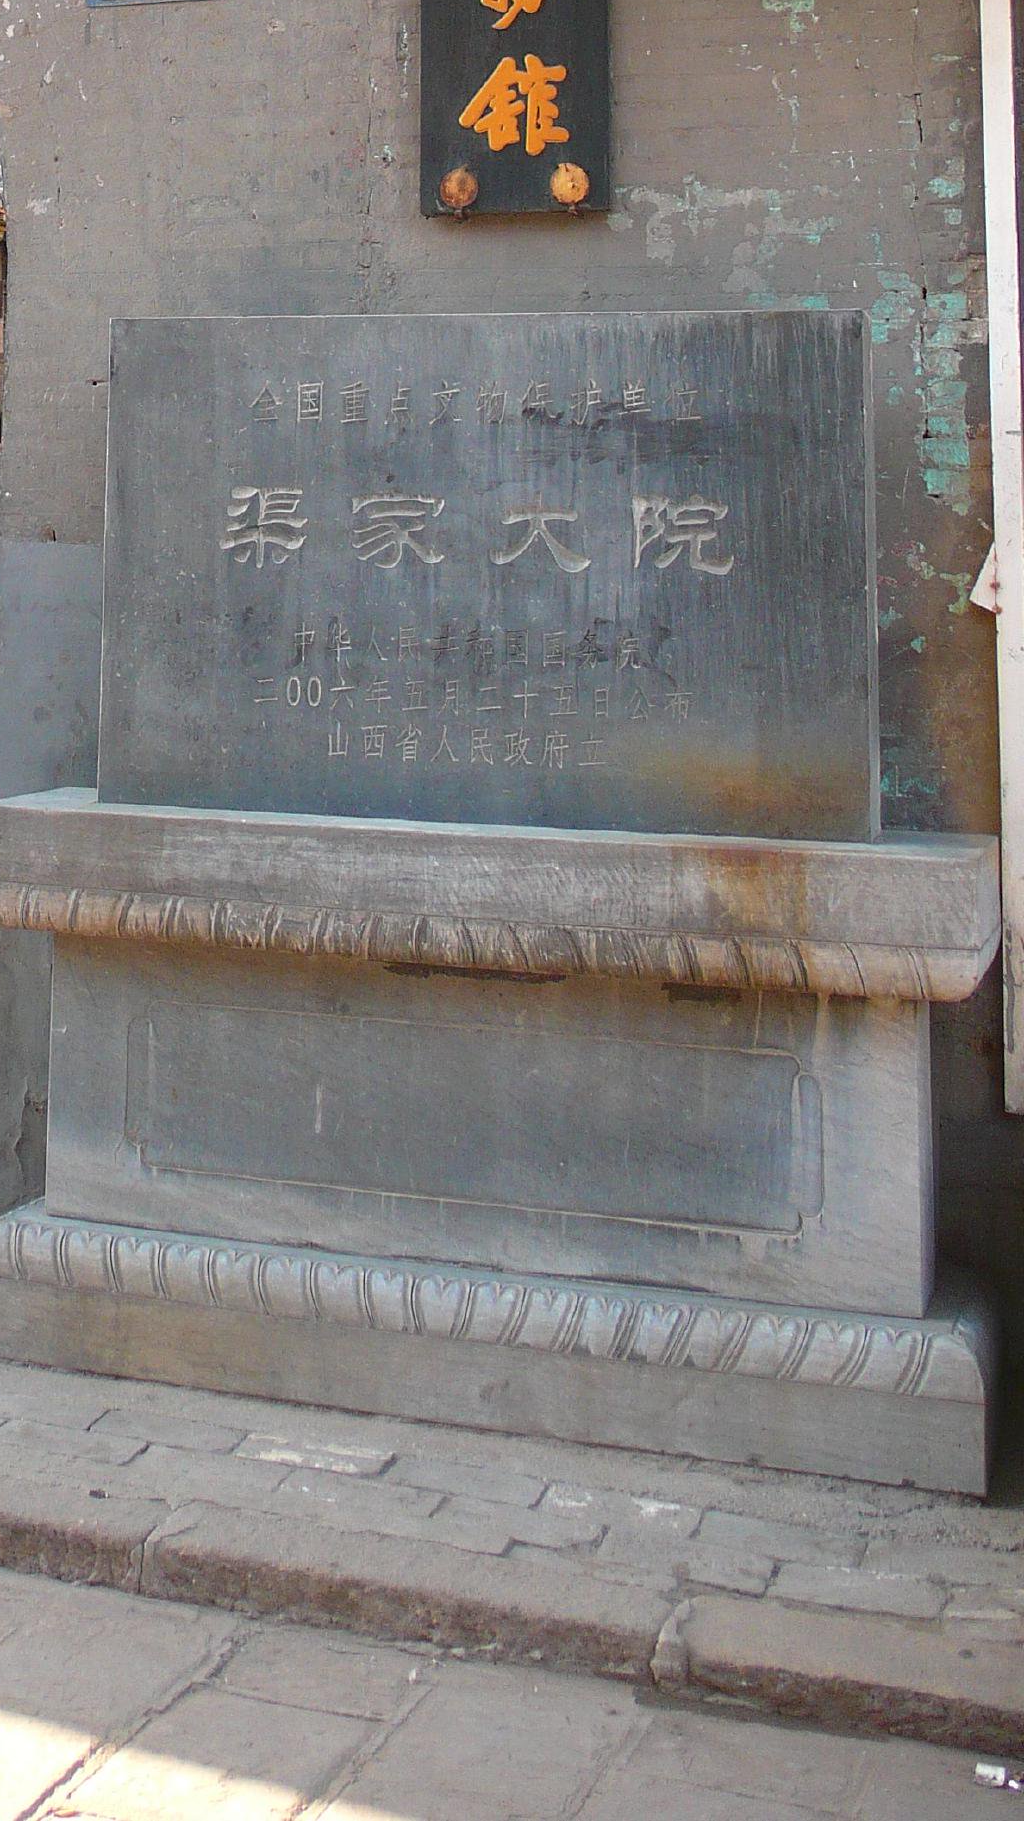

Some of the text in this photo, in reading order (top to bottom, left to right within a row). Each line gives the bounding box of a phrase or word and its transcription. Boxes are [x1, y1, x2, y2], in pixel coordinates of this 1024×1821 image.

[248, 379, 703, 427] 全国重点文物保护单位
[219, 485, 735, 576] 渠家大院
[293, 618, 643, 671] 中华人民共和国国务院
[327, 721, 608, 768] 山西省人民政府立
